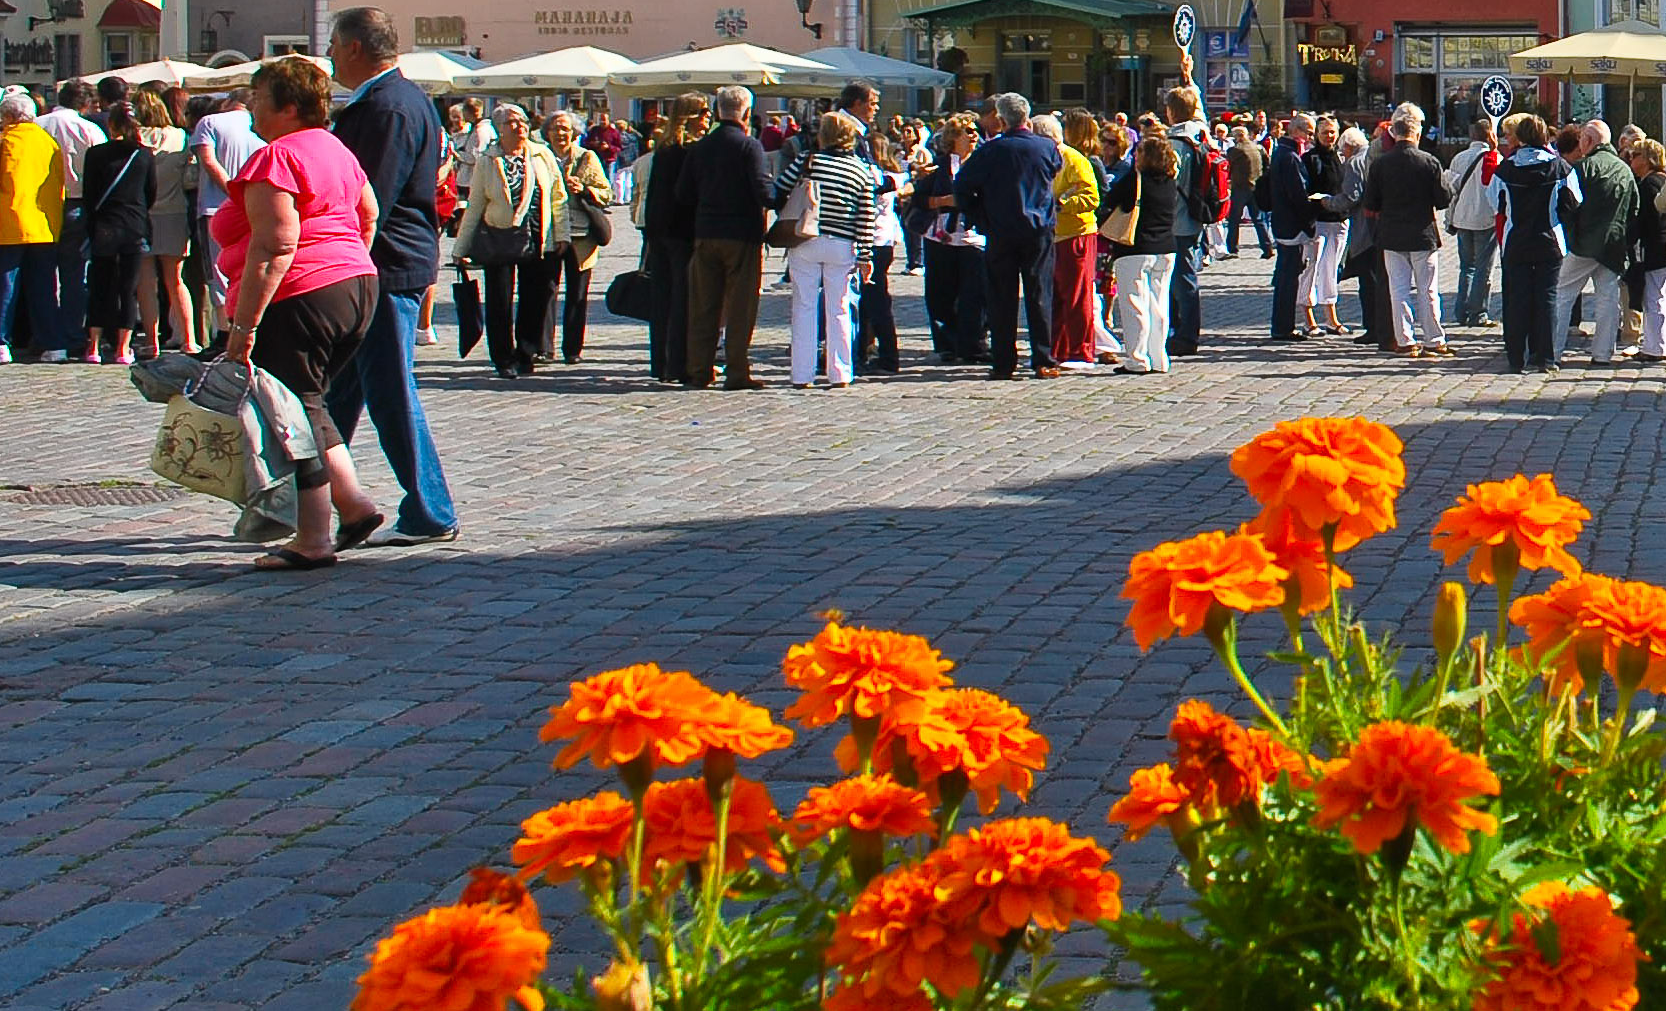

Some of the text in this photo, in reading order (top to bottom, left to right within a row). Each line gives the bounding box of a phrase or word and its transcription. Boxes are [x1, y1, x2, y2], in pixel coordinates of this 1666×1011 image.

[534, 10, 633, 24] MAHARAJA
[1526, 58, 1553, 70] saku
[1590, 57, 1617, 70] saku
